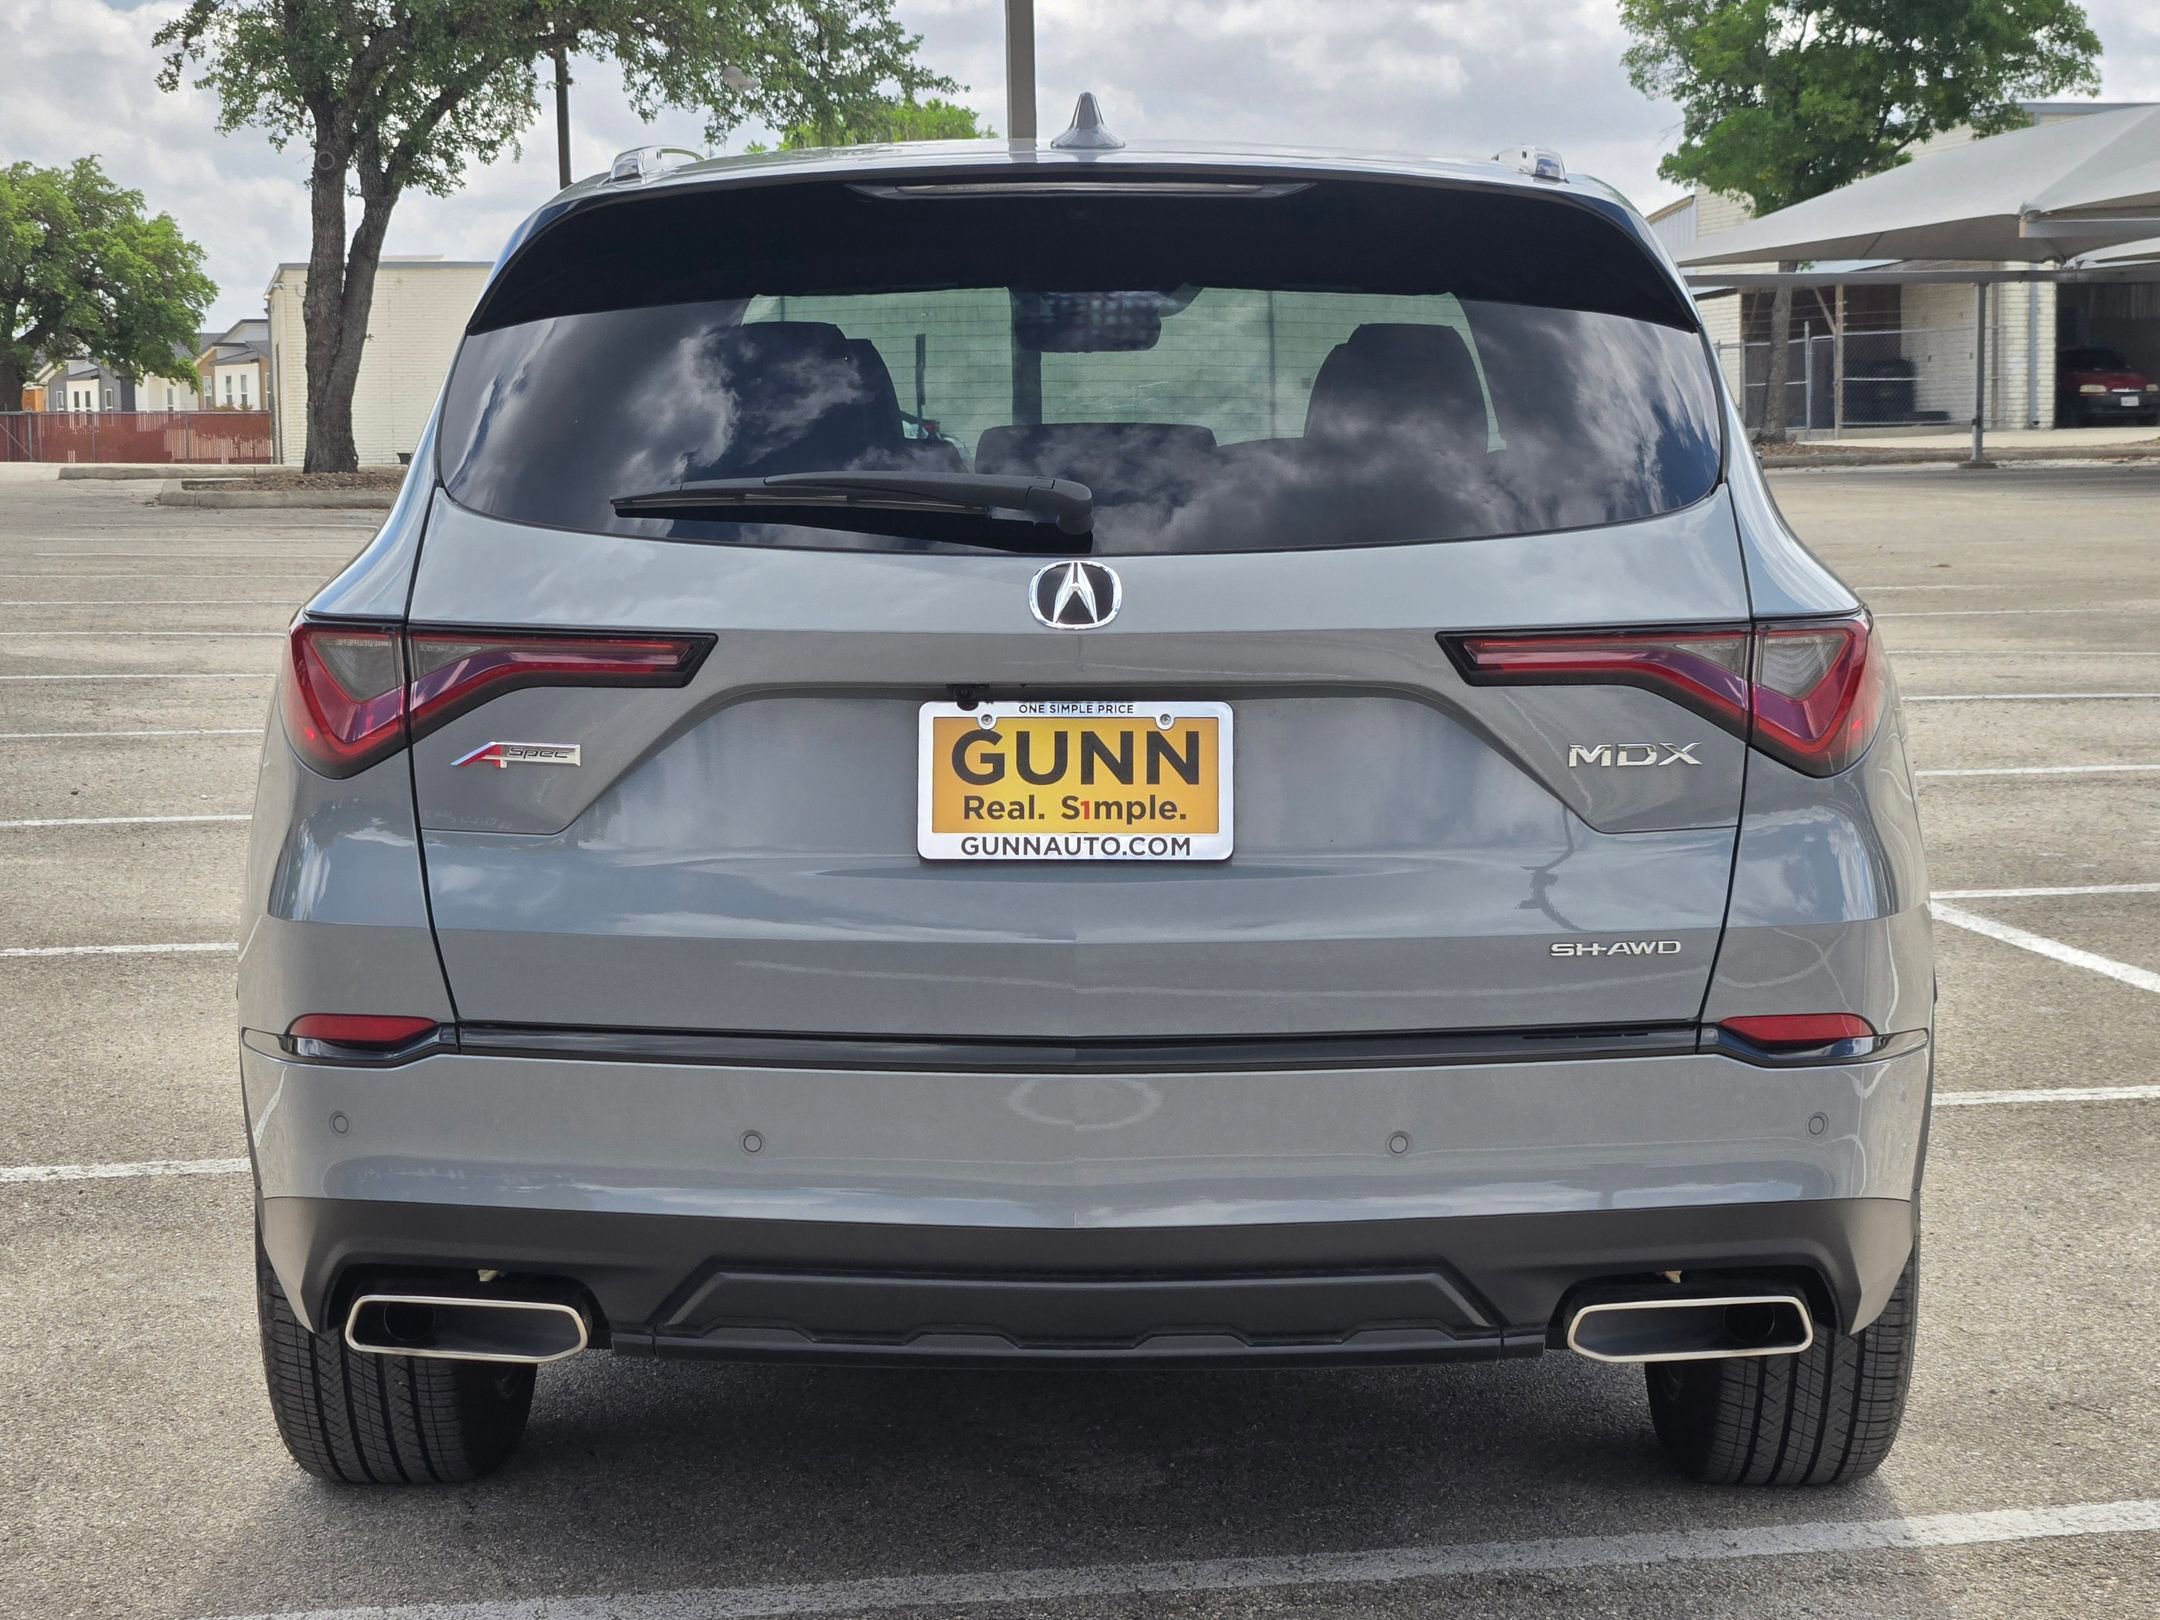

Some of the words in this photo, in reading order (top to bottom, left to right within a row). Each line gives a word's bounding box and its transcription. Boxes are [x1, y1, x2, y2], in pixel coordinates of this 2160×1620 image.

[1018, 704, 1046, 714] ONE
[1049, 704, 1094, 714] SIMPLE
[1097, 704, 1134, 714] PRICE
[951, 729, 1200, 786] GUNN
[1568, 742, 1703, 768] MDX
[963, 794, 1046, 821] Real.
[960, 836, 1191, 857] GUNNAUTO.COM
[1550, 940, 1682, 957] SH-AWD
